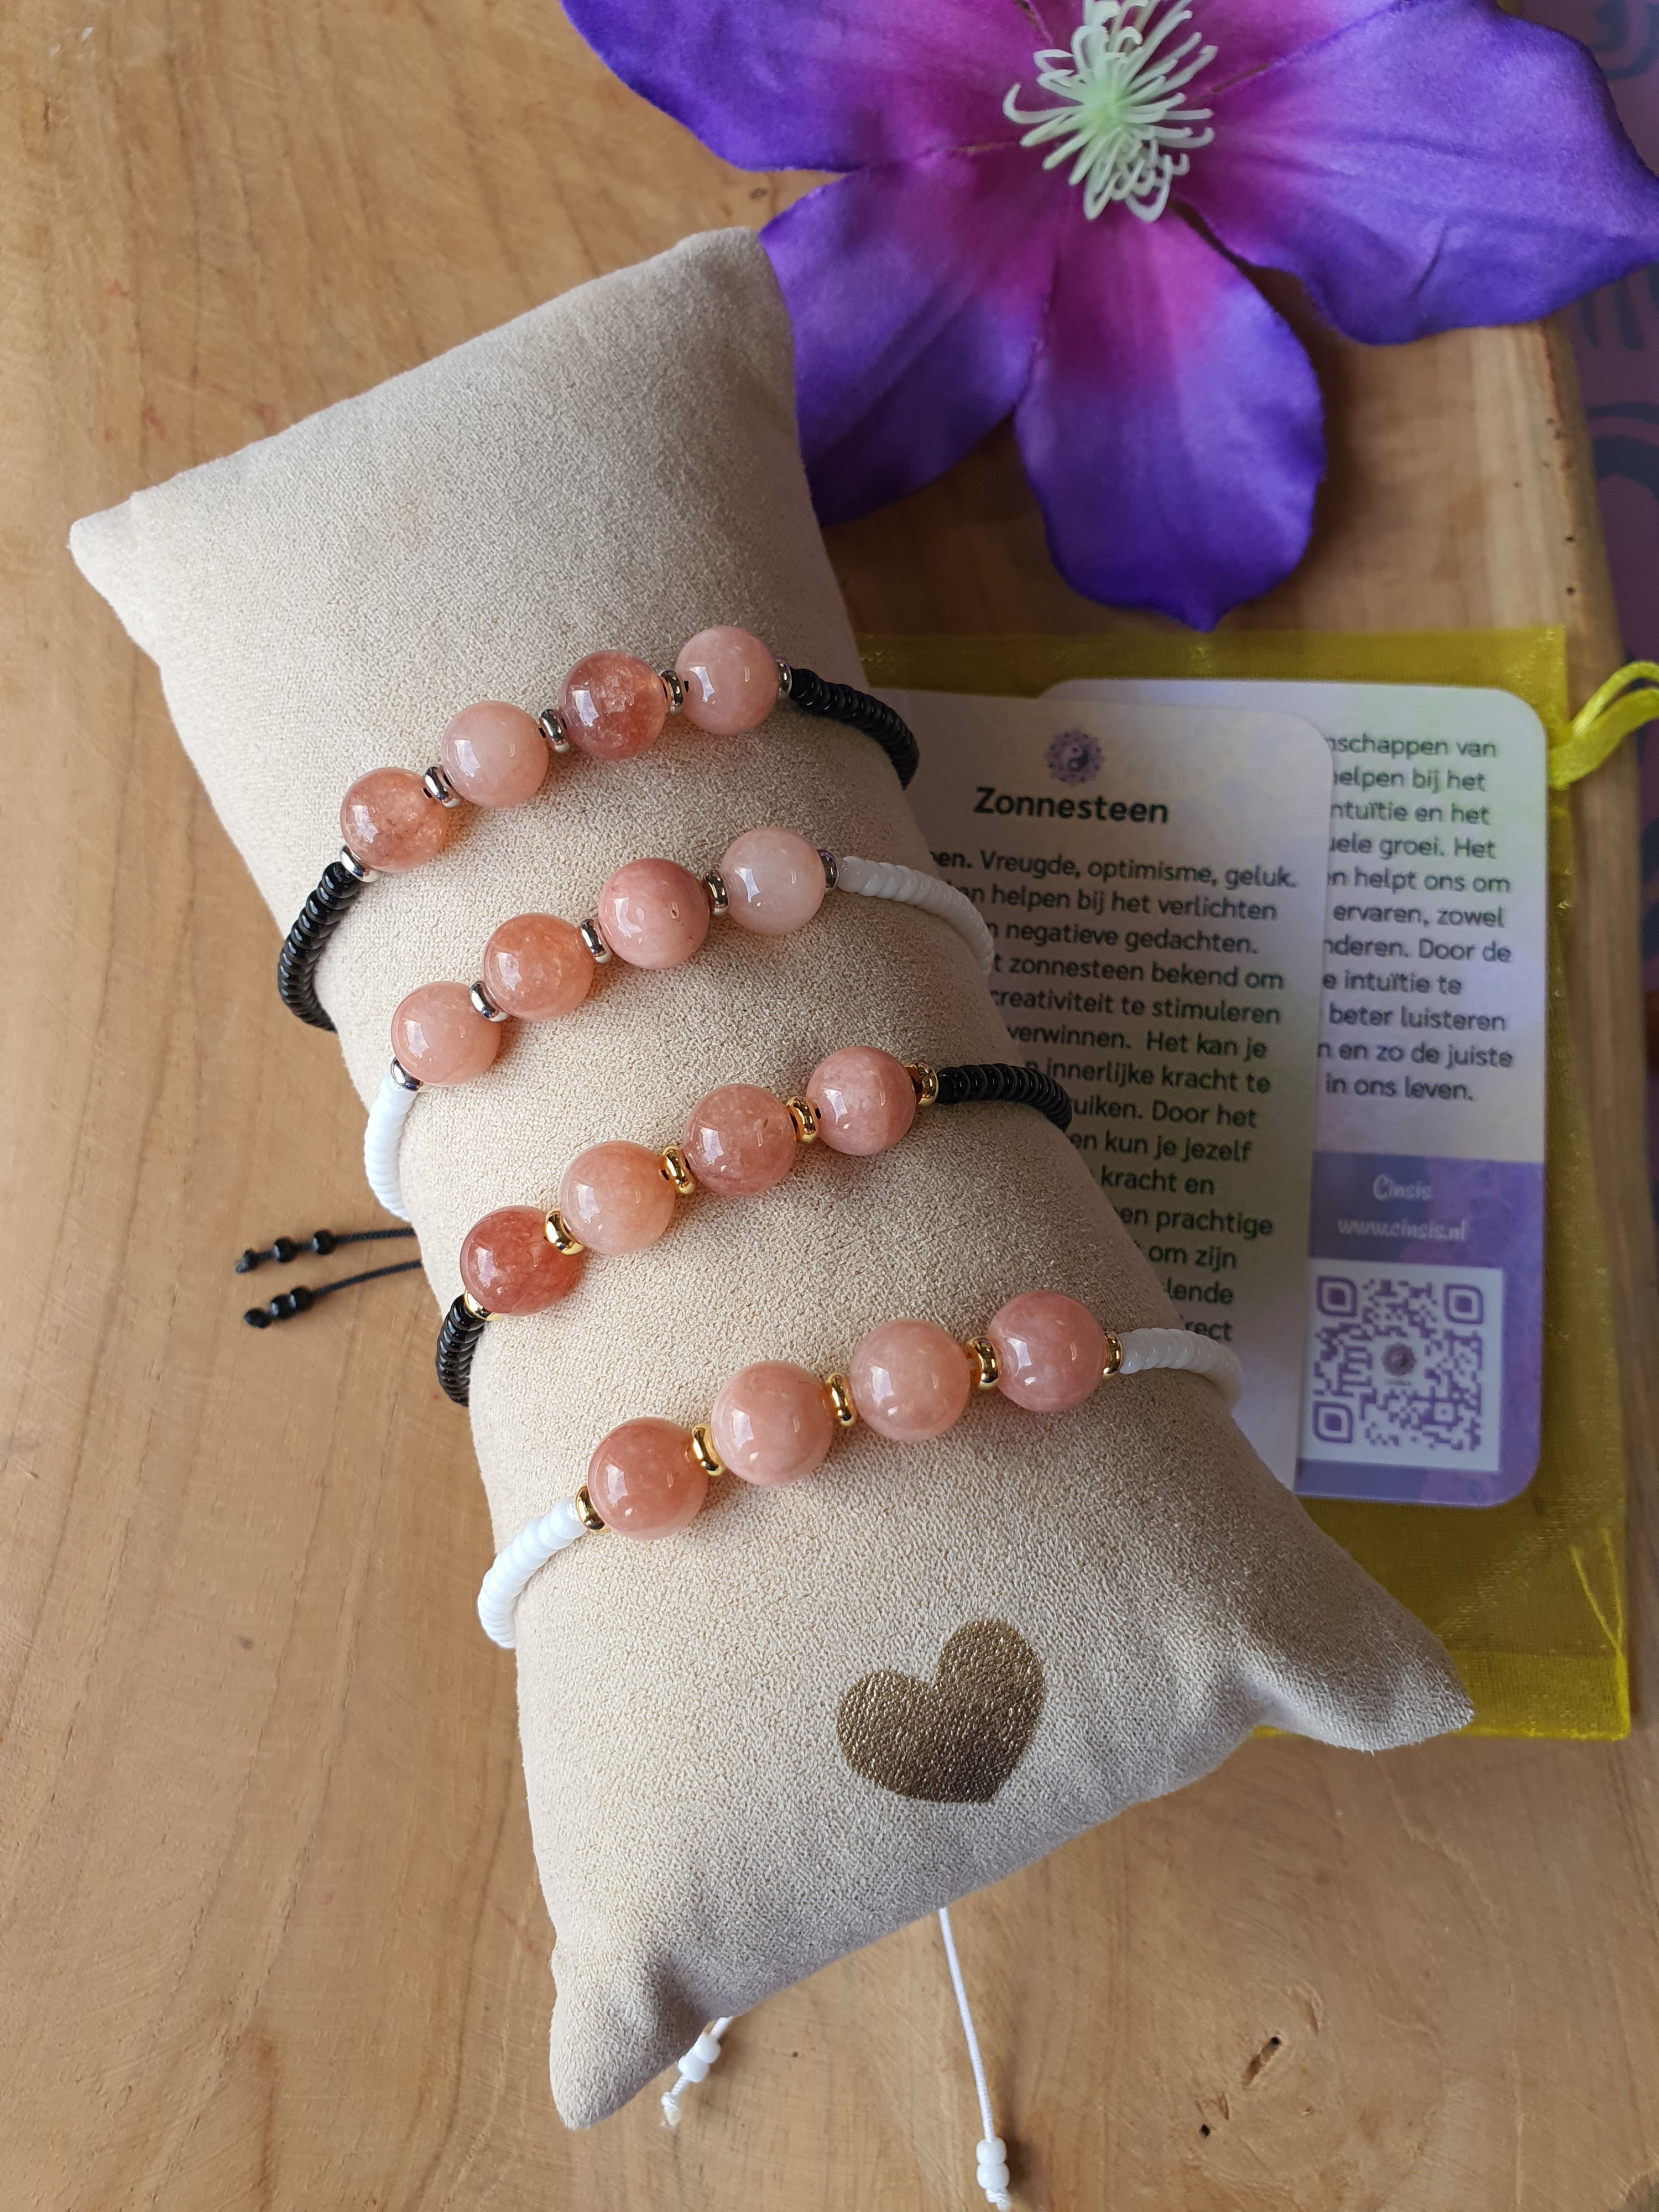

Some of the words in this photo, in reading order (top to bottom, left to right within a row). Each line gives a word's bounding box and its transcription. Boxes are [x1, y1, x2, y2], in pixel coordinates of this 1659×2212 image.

[1457, 741, 1496, 759] van
[1412, 768, 1439, 794] bij
[1447, 769, 1486, 792] het
[974, 787, 1168, 824] Zonnesteen
[1415, 806, 1442, 823] en
[1451, 804, 1490, 826] het
[1379, 836, 1444, 860] groei.
[1454, 838, 1496, 860] Het
[929, 851, 972, 868] en.
[980, 850, 1081, 878] Vreugde,
[1088, 859, 1217, 886] optimisme,
[1225, 865, 1296, 891] geluk.
[1354, 867, 1416, 894] helpt
[1424, 874, 1465, 893] ons
[1472, 877, 1510, 894] om
[992, 884, 1069, 911] helpen
[1077, 889, 1104, 915] bij
[1111, 891, 1150, 915] het
[1157, 896, 1277, 921] verlichten
[1333, 905, 1430, 926] ervaren,
[1436, 905, 1504, 929] zowel
[1006, 921, 1117, 948] negatieve
[1125, 926, 1258, 955] gedachten.
[1418, 940, 1475, 961] Door
[1483, 942, 1511, 963] de
[1009, 957, 1144, 981] zonnesteen
[1152, 961, 1238, 987] bekend
[1245, 972, 1284, 990] om
[1438, 976, 1462, 995] te
[1122, 997, 1145, 1016] te
[1152, 998, 1280, 1024] stimuleren
[1329, 1003, 1392, 1026] beter
[1400, 1008, 1506, 1032] luisteren
[1146, 1030, 1188, 1051] Het
[1197, 1034, 1238, 1057] kan
[1243, 1037, 1267, 1062] je
[1339, 1043, 1367, 1060] en
[1376, 1045, 1404, 1062] zo
[1411, 1043, 1440, 1065] de
[1446, 1045, 1513, 1071] juiste
[1047, 1057, 1154, 1087] innerlijke
[1161, 1065, 1238, 1092] kracht
[1246, 1072, 1270, 1093] te
[1326, 1073, 1345, 1094] in
[1354, 1078, 1396, 1098] ons
[1405, 1077, 1473, 1102] leven.
[1152, 1100, 1209, 1125] Door
[1217, 1105, 1258, 1129] het
[1105, 1130, 1147, 1154] kun
[1155, 1135, 1177, 1160] je
[1181, 1139, 1252, 1163] jezelf
[1101, 1164, 1177, 1193] kracht
[1185, 1175, 1214, 1194] en
[1156, 1208, 1273, 1240] prachtige
[1148, 1246, 1187, 1264] om
[1195, 1246, 1237, 1271] zijn
